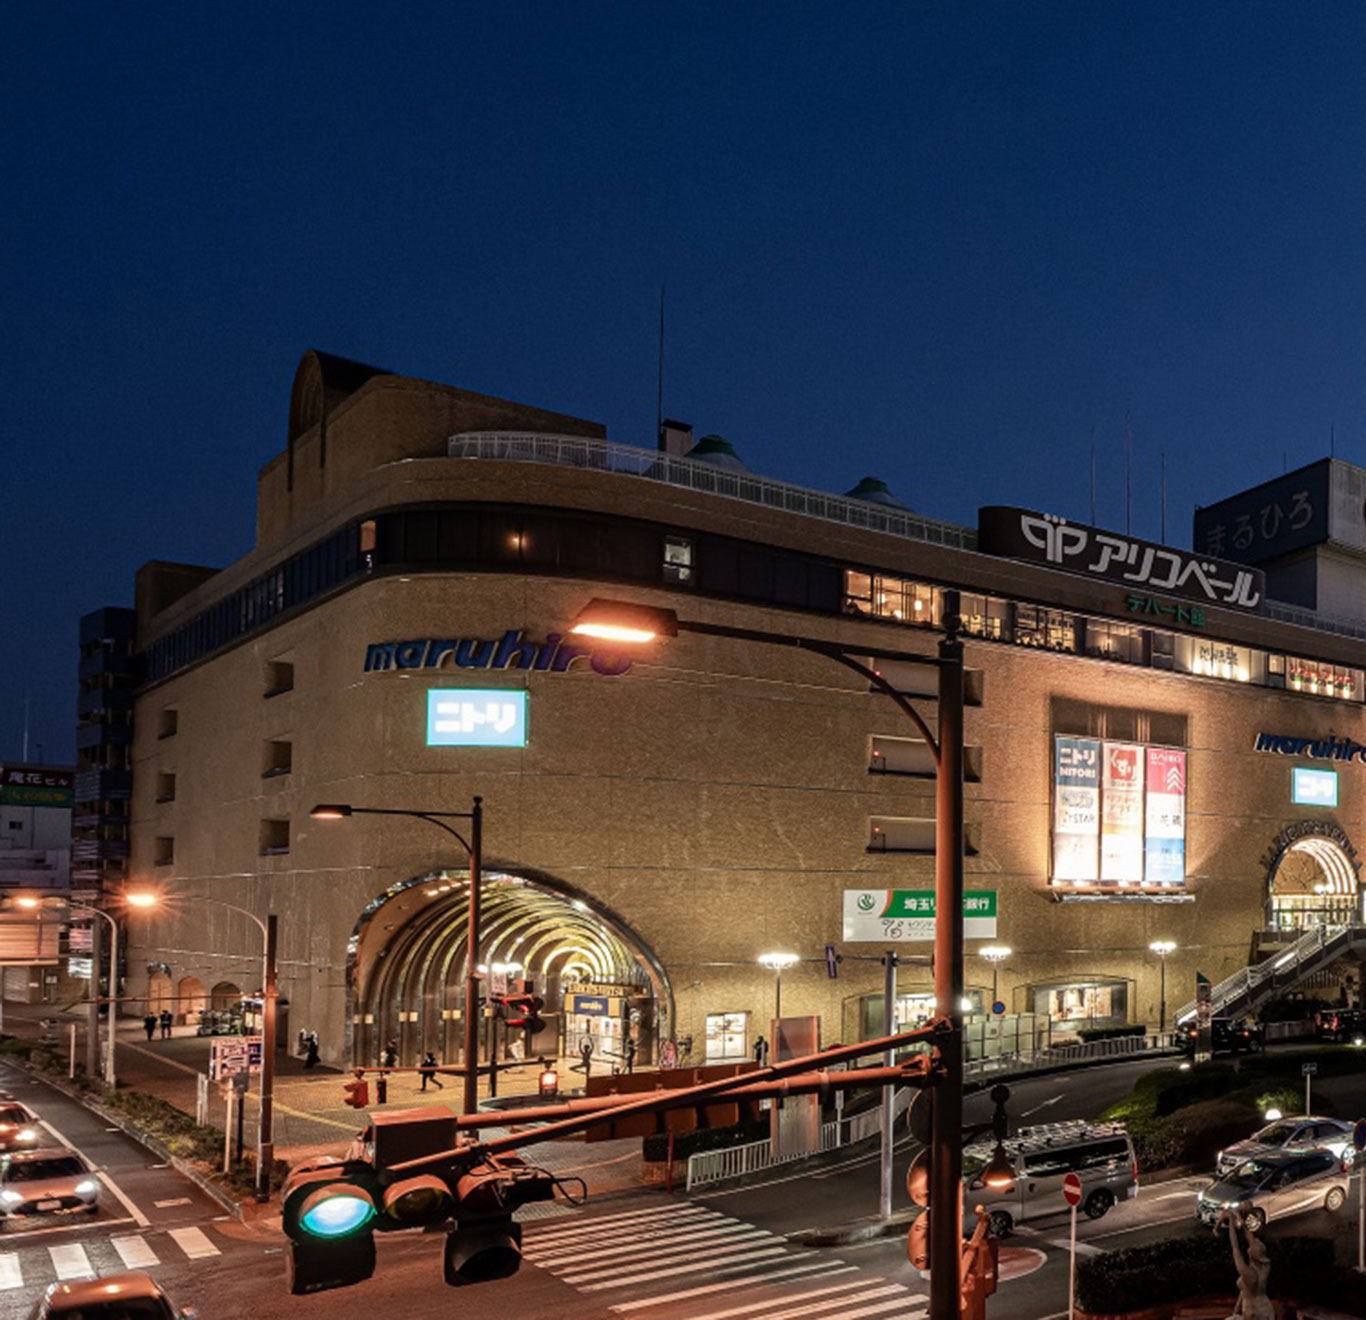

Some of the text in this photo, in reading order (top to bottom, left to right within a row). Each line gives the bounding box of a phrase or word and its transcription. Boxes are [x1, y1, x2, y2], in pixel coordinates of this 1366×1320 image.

[1206, 489, 1314, 560] まるひろ
[1088, 533, 1261, 608] アリコベール
[363, 630, 633, 676] maruhiro
[435, 702, 517, 734] ニトリ
[1060, 747, 1096, 766] ニトリ
[1060, 766, 1096, 778] NITORI
[903, 897, 990, 911] 埼玉銀行
